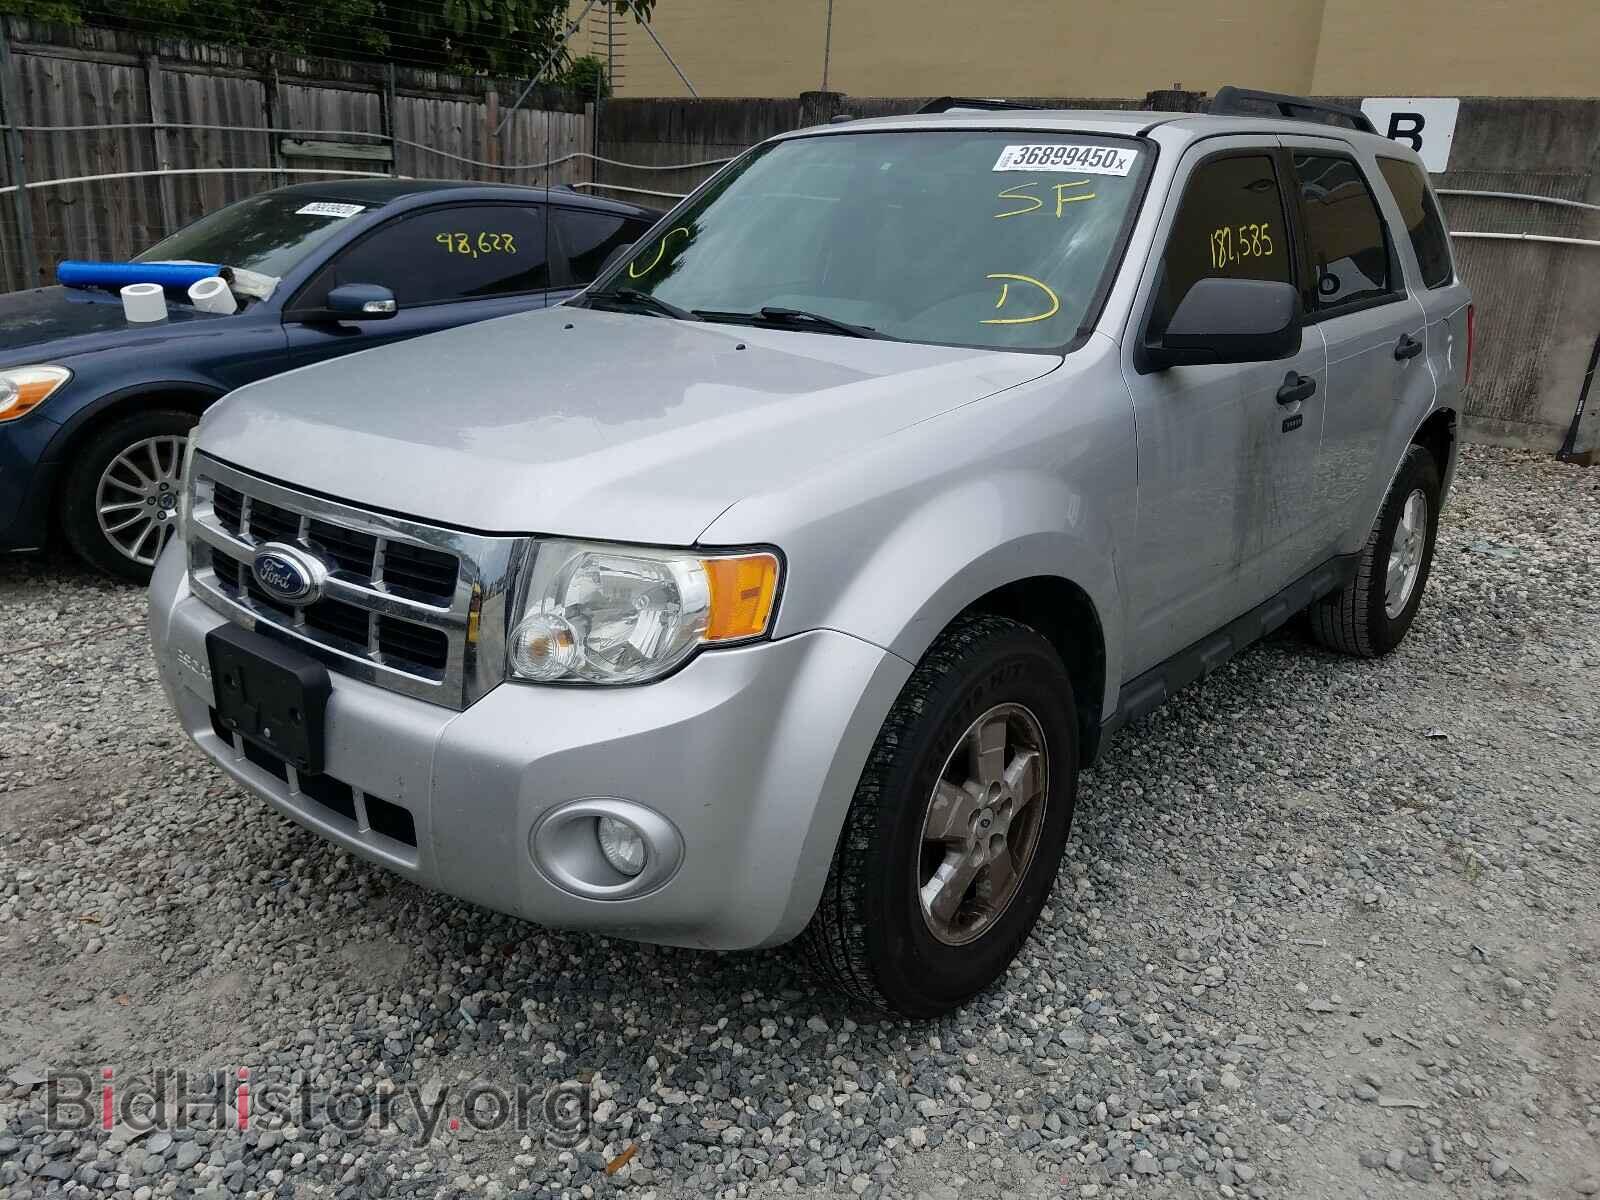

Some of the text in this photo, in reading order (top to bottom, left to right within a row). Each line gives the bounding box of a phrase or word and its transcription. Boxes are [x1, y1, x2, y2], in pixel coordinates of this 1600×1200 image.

[1387, 112, 1426, 153] B
[978, 273, 1061, 325] D
[260, 558, 292, 589] Ford
